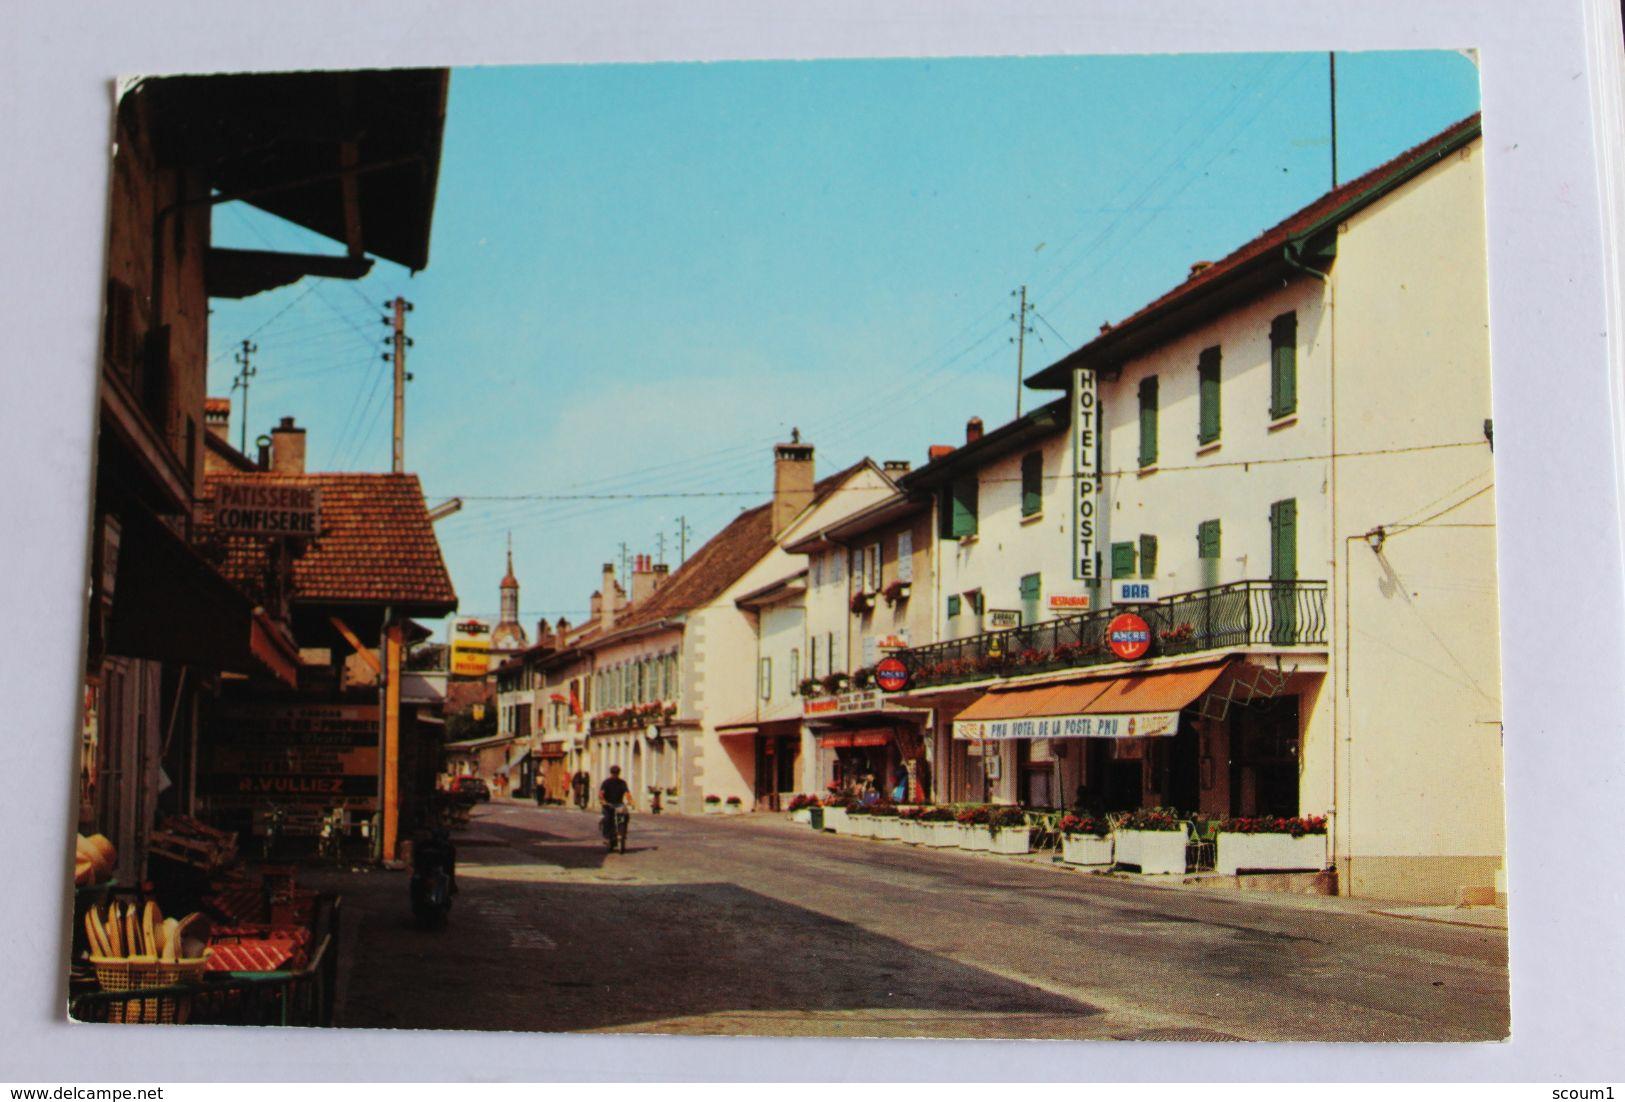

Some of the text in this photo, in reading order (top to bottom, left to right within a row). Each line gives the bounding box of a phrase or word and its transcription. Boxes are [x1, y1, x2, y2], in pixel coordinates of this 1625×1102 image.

[1080, 372, 1093, 466] HOTEL
[221, 485, 315, 509] PATISSERIE
[219, 508, 316, 531] CONFISERIE
[1080, 482, 1093, 576] POSTE
[1121, 584, 1149, 599] BAR
[1112, 631, 1147, 642] ANCRE
[1039, 721, 1048, 736] DE
[1052, 720, 1061, 735] LA
[1065, 719, 1091, 736] POSTE
[1097, 719, 1118, 735] PMU
